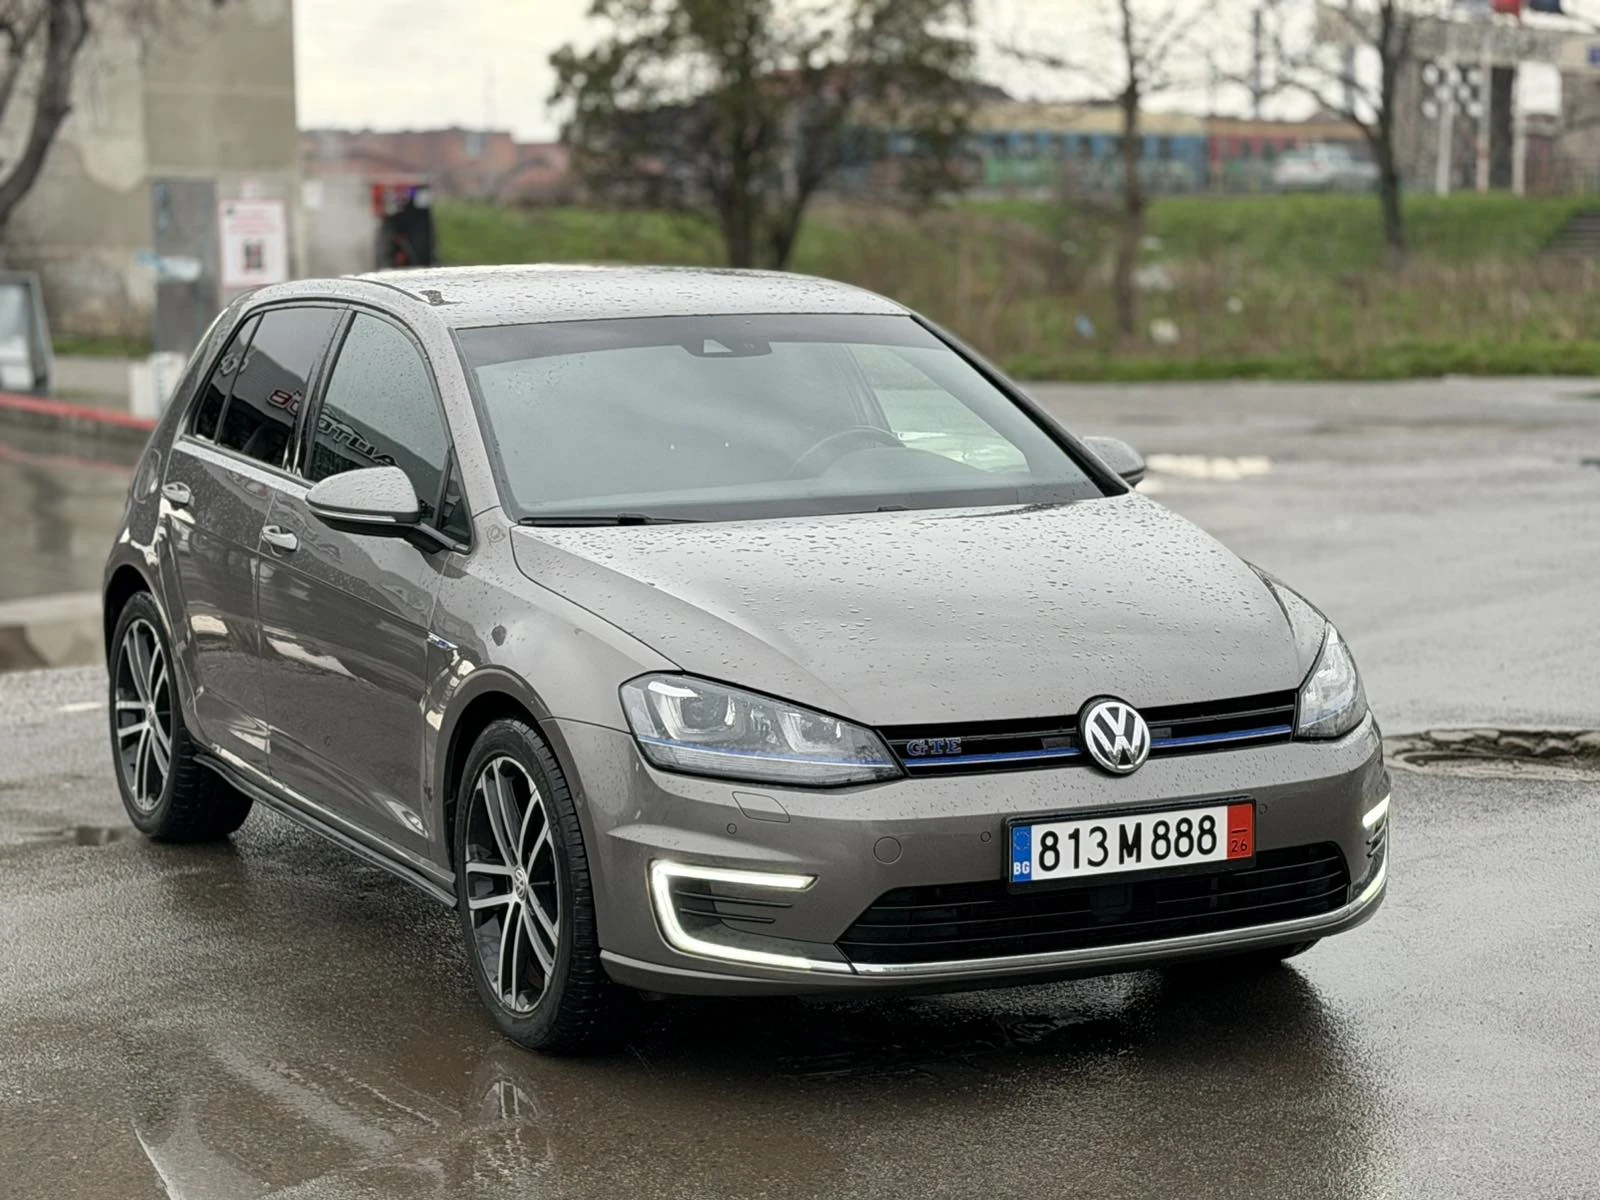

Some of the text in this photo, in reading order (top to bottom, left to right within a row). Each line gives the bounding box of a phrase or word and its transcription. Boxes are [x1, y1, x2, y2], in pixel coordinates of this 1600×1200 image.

[906, 737, 962, 756] GTE
[1086, 701, 1150, 773] VW
[1038, 814, 1217, 872] 813 M 888
[1231, 838, 1248, 852] 26
[1013, 861, 1030, 875] BG
